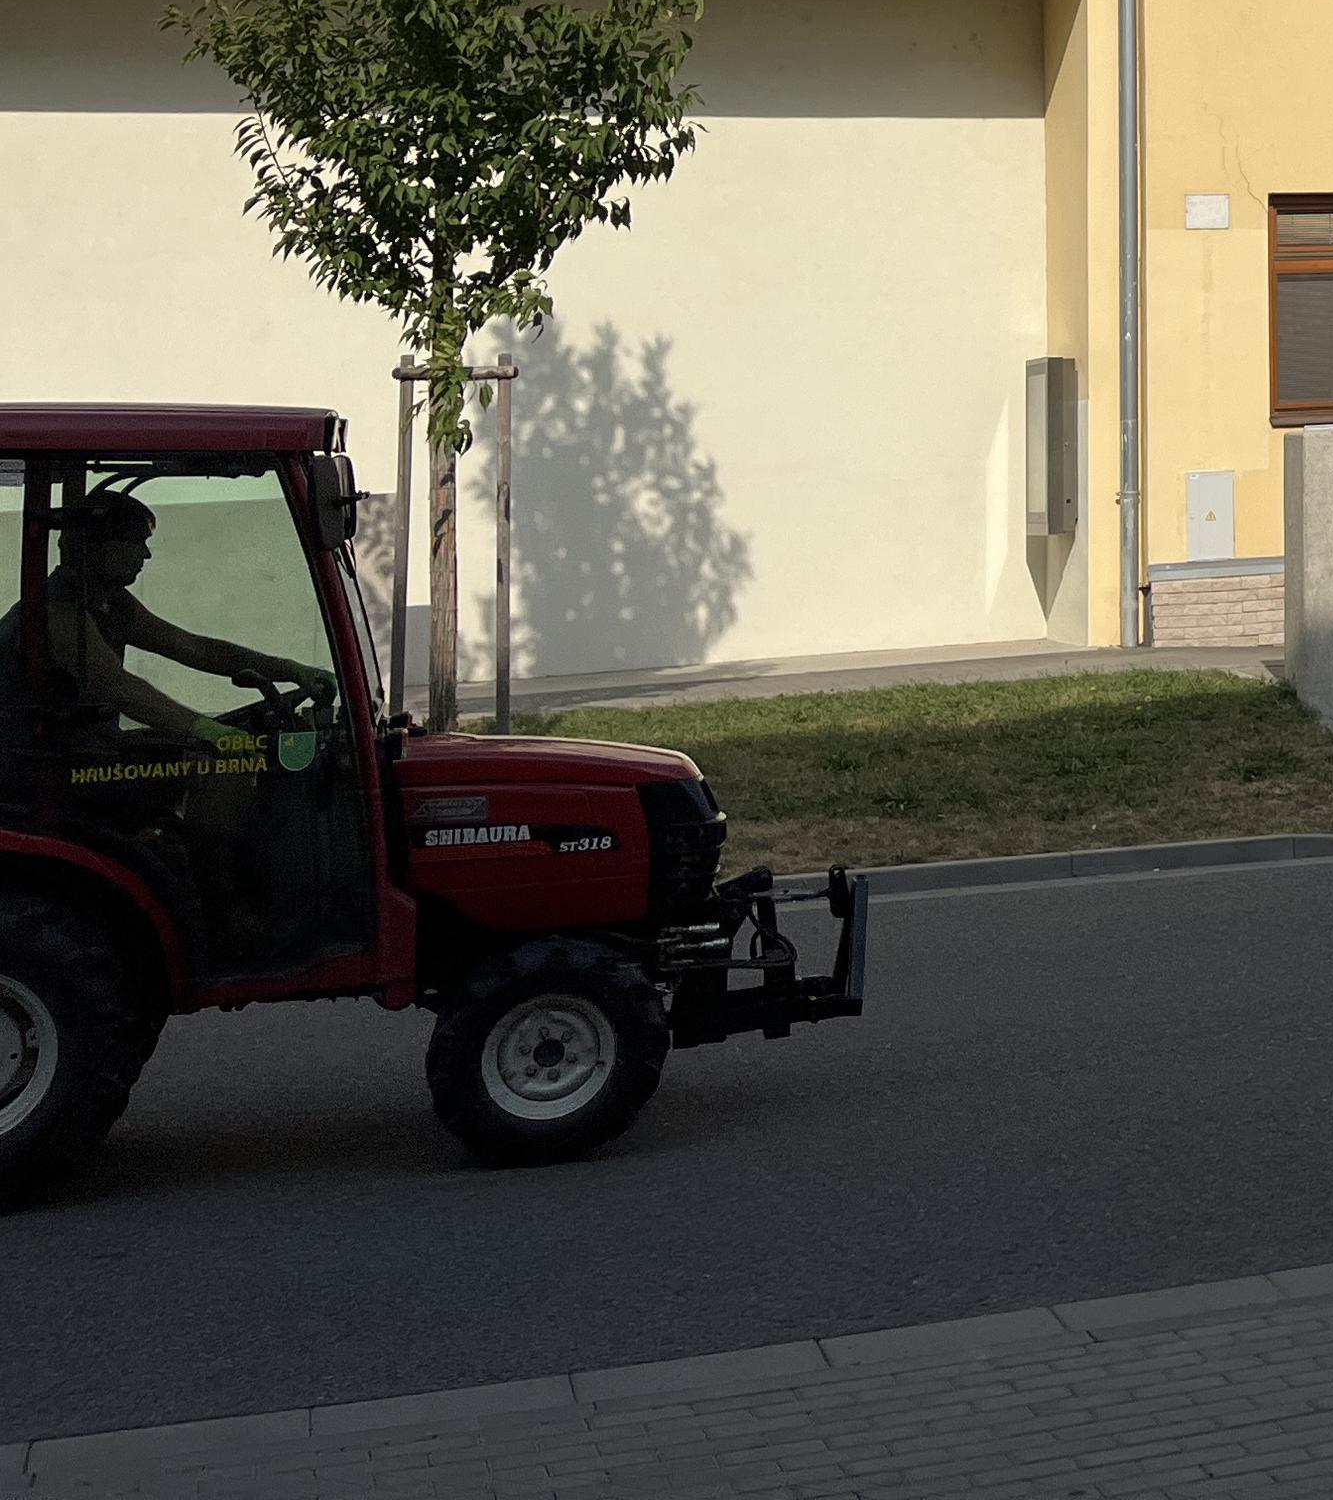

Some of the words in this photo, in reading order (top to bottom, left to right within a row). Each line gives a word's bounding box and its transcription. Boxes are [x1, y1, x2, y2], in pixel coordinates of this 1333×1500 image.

[216, 734, 268, 751] OBEC
[71, 760, 193, 785] HRUŠOVANY
[198, 758, 210, 775] U
[215, 755, 268, 775] BRNA
[424, 825, 532, 846] SHIBAURA
